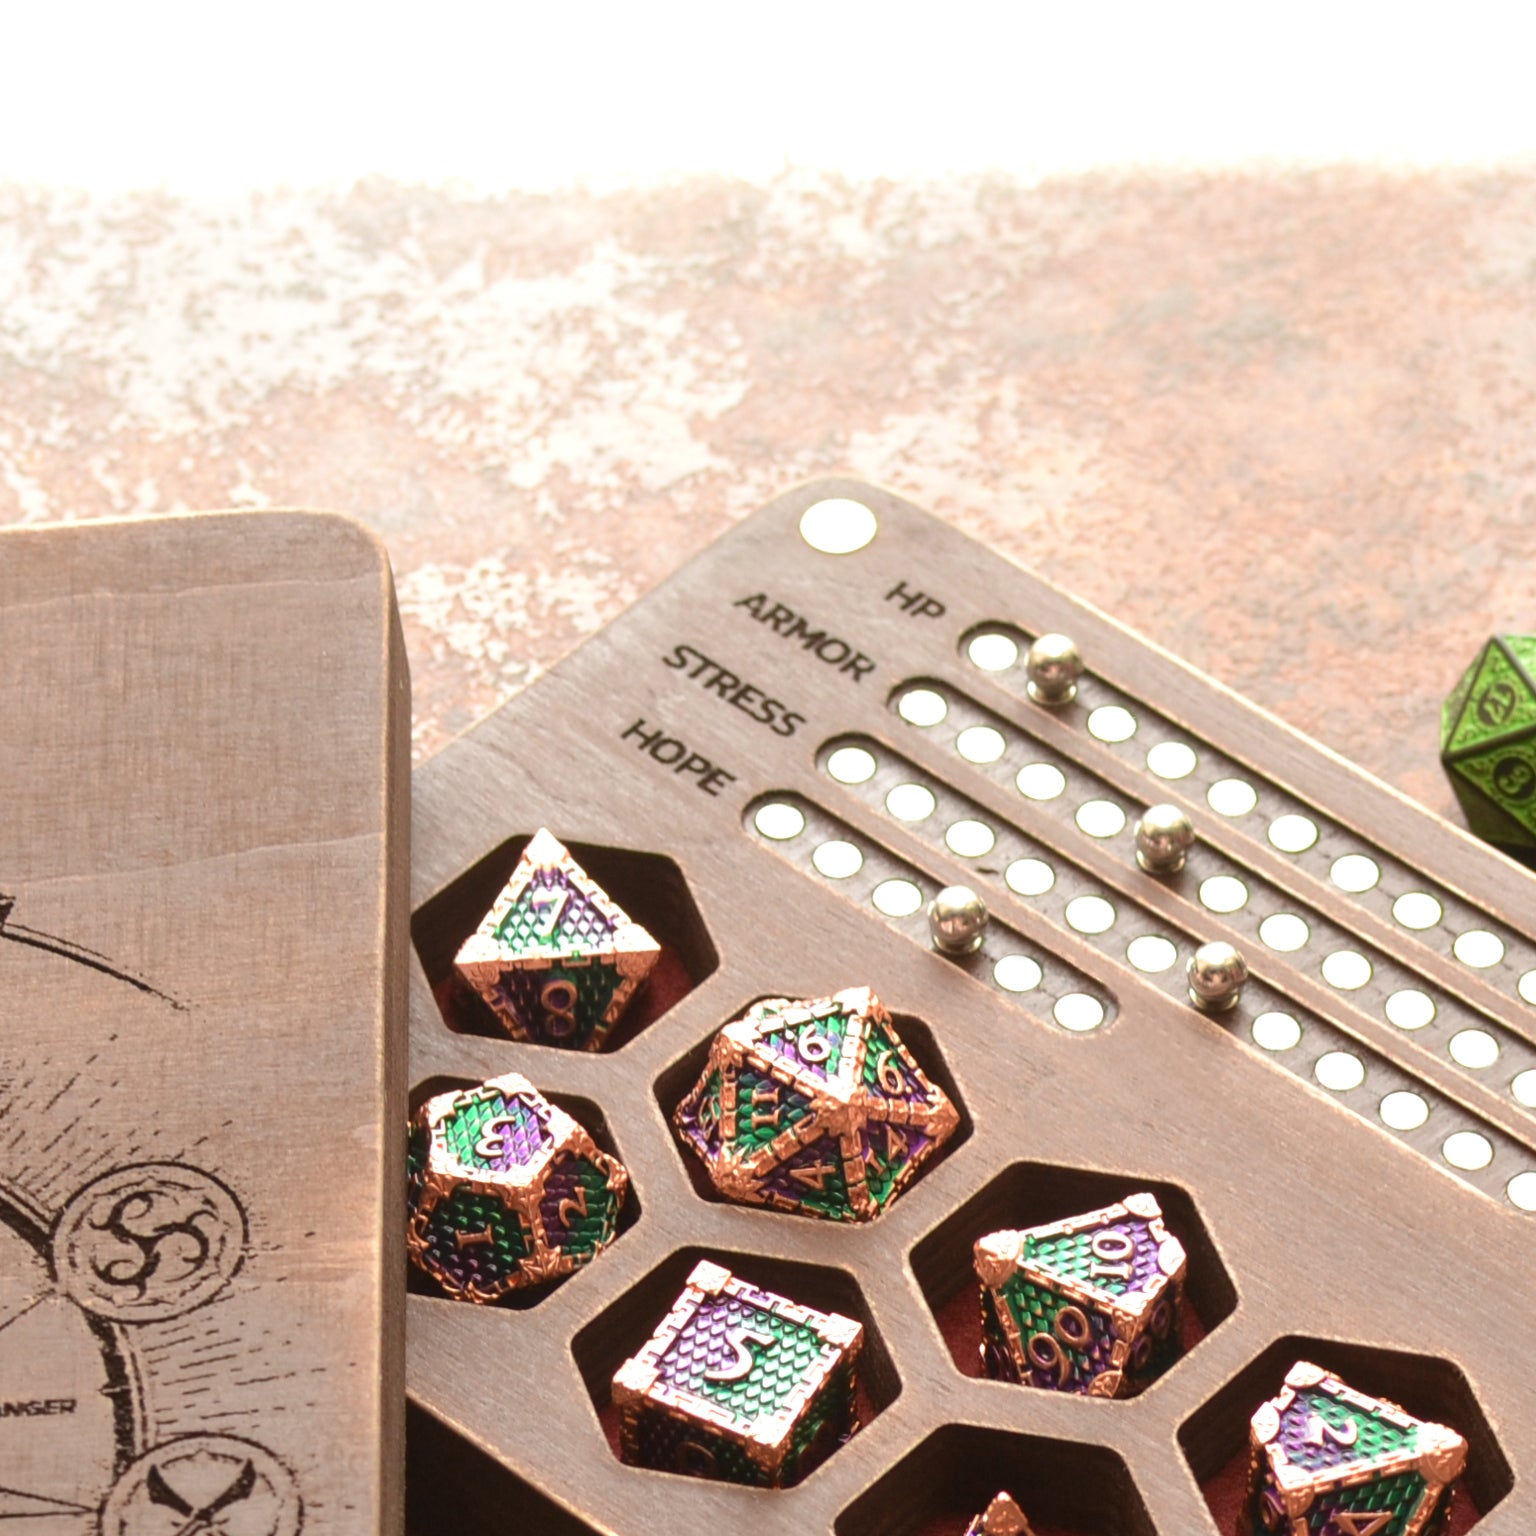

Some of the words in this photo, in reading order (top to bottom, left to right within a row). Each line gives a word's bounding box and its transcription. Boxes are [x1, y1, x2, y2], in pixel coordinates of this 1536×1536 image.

[885, 580, 947, 623] HP
[734, 592, 877, 682] ARMOR
[662, 644, 808, 737] STRESS
[621, 719, 737, 796] HOPE
[532, 887, 569, 937] 7
[541, 980, 576, 1036] 8
[475, 1117, 515, 1156] 3
[791, 1164, 835, 1189] 4
[1091, 1231, 1133, 1280] 10
[705, 1328, 774, 1382] 5
[1305, 1416, 1357, 1445] 2
